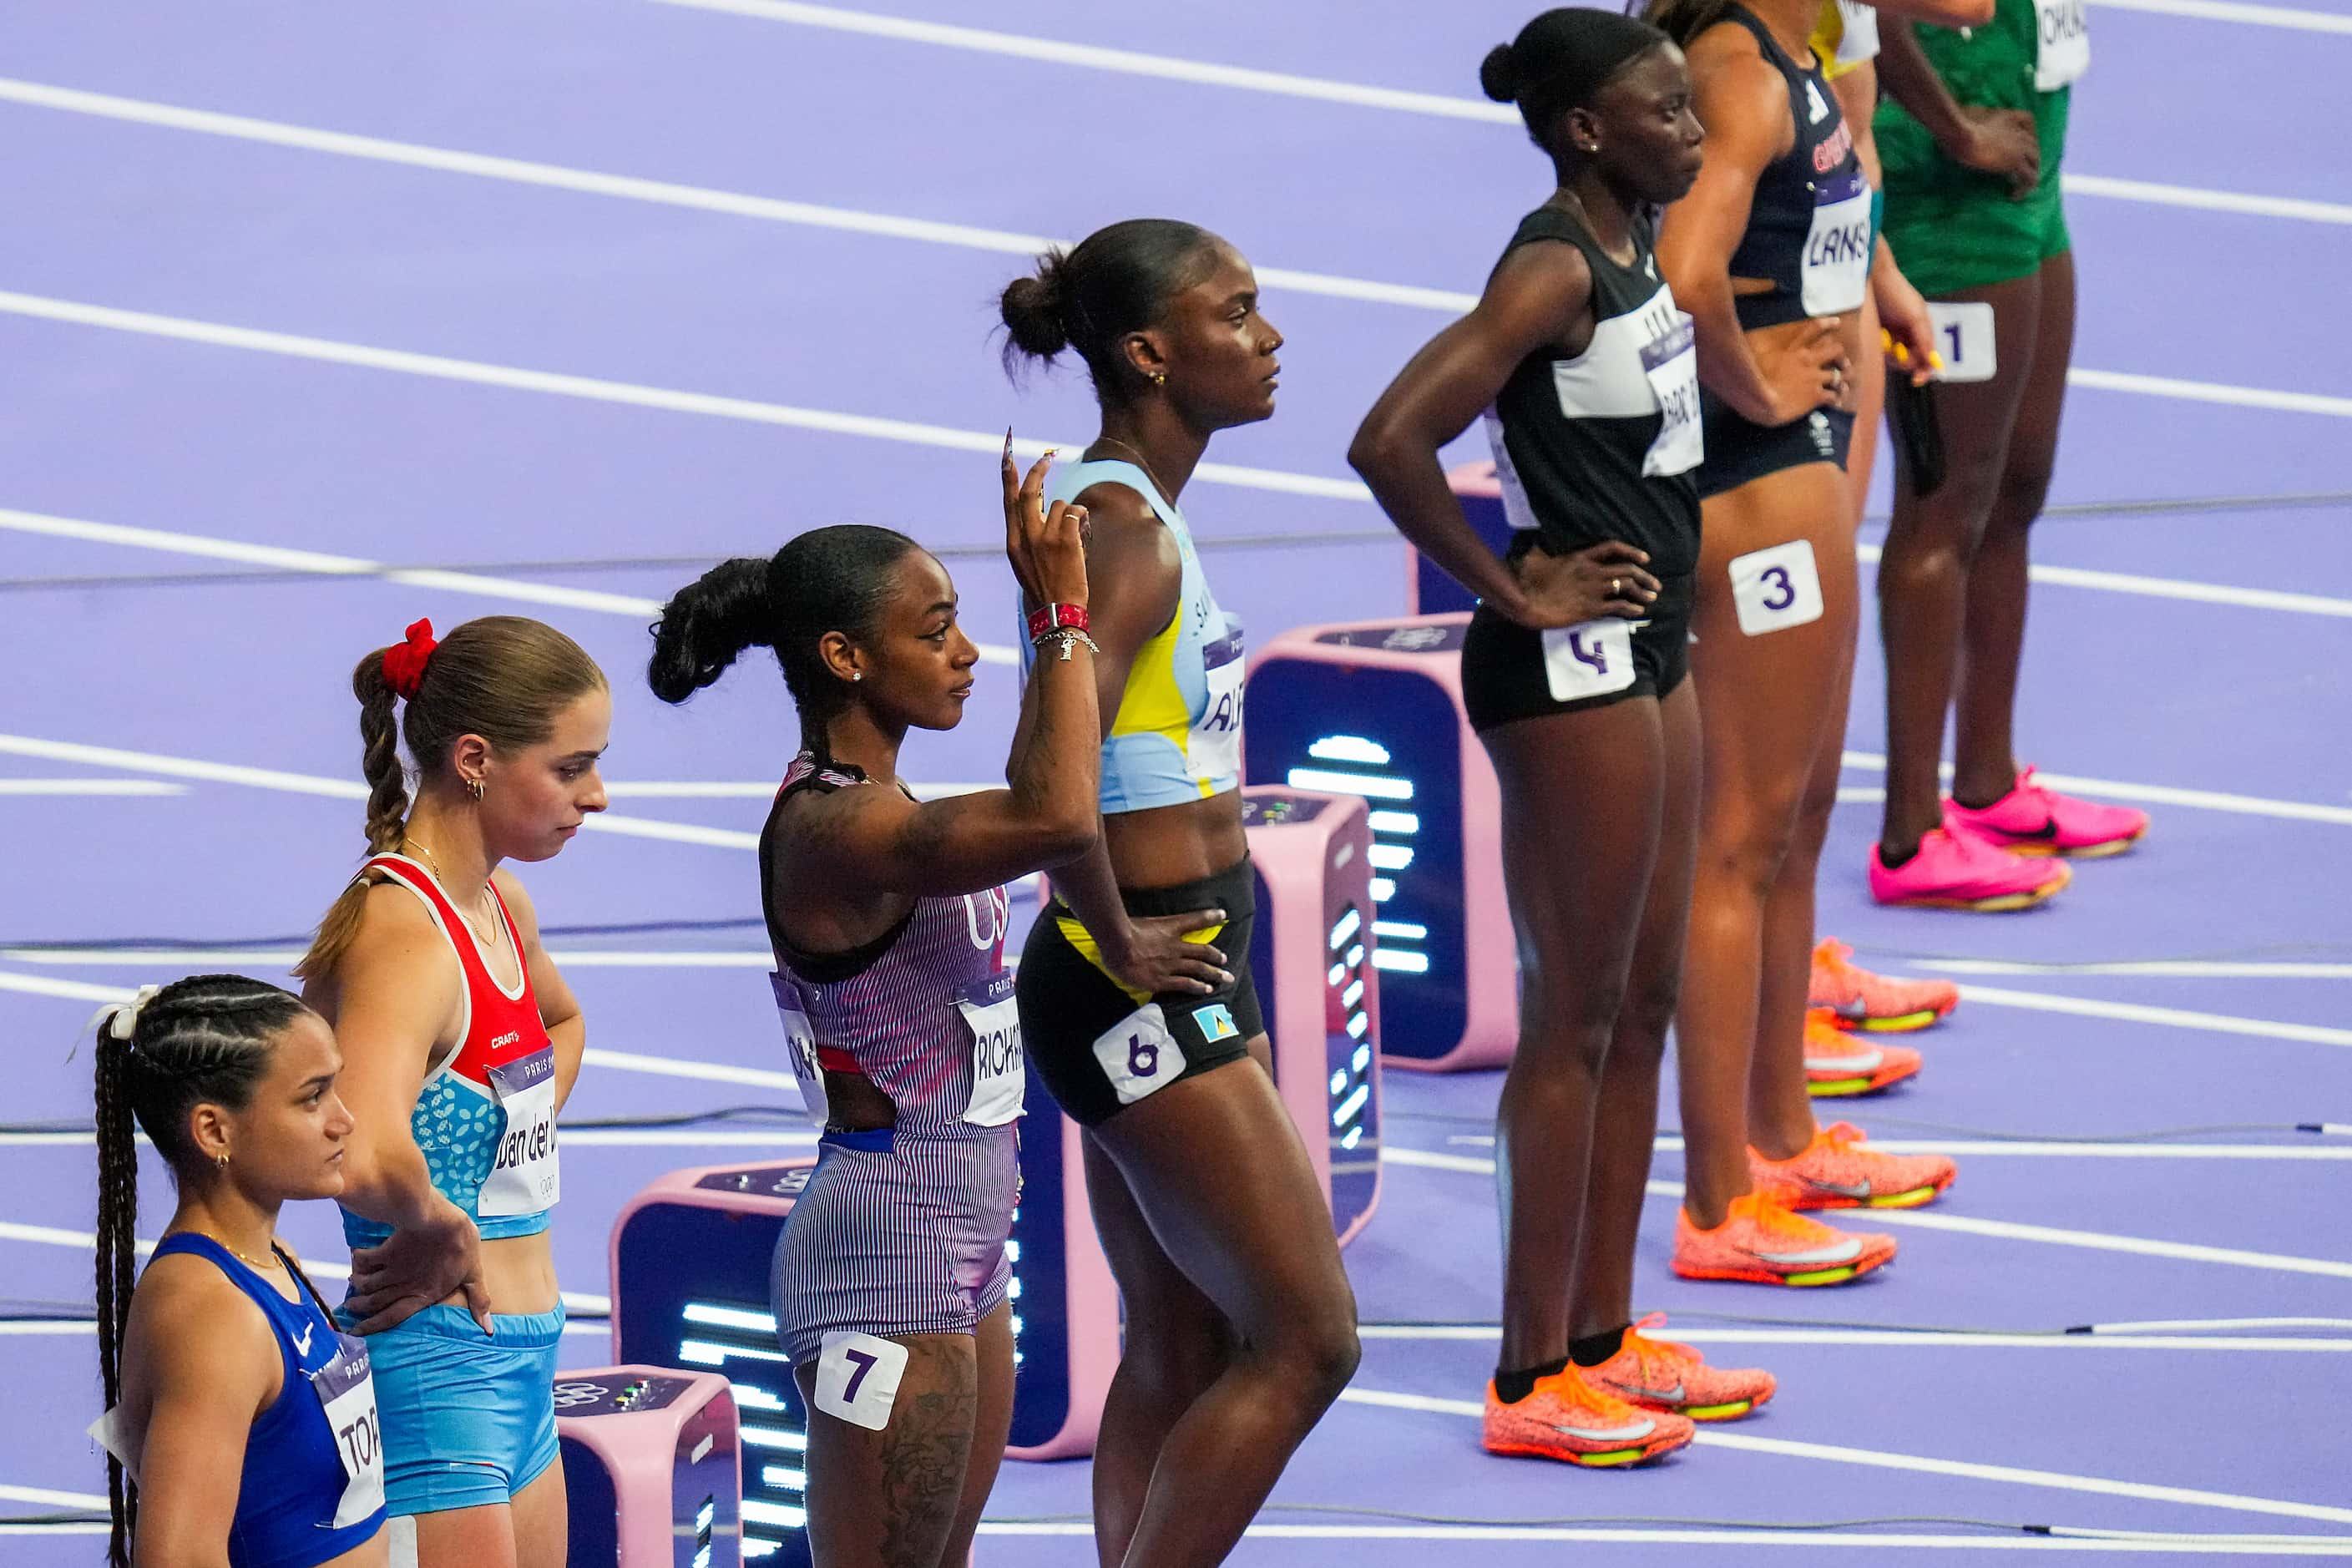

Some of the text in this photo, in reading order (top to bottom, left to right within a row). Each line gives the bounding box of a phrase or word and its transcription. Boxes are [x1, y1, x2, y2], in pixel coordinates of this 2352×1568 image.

[1943, 324, 1960, 362] 1
[1760, 566, 1795, 610] 3
[1570, 630, 1609, 675] 4
[490, 1030, 517, 1050] CRAFT
[1128, 1033, 1159, 1078] 6
[524, 1057, 549, 1080] PARIS
[529, 1112, 549, 1161] der
[842, 1348, 878, 1404] 7
